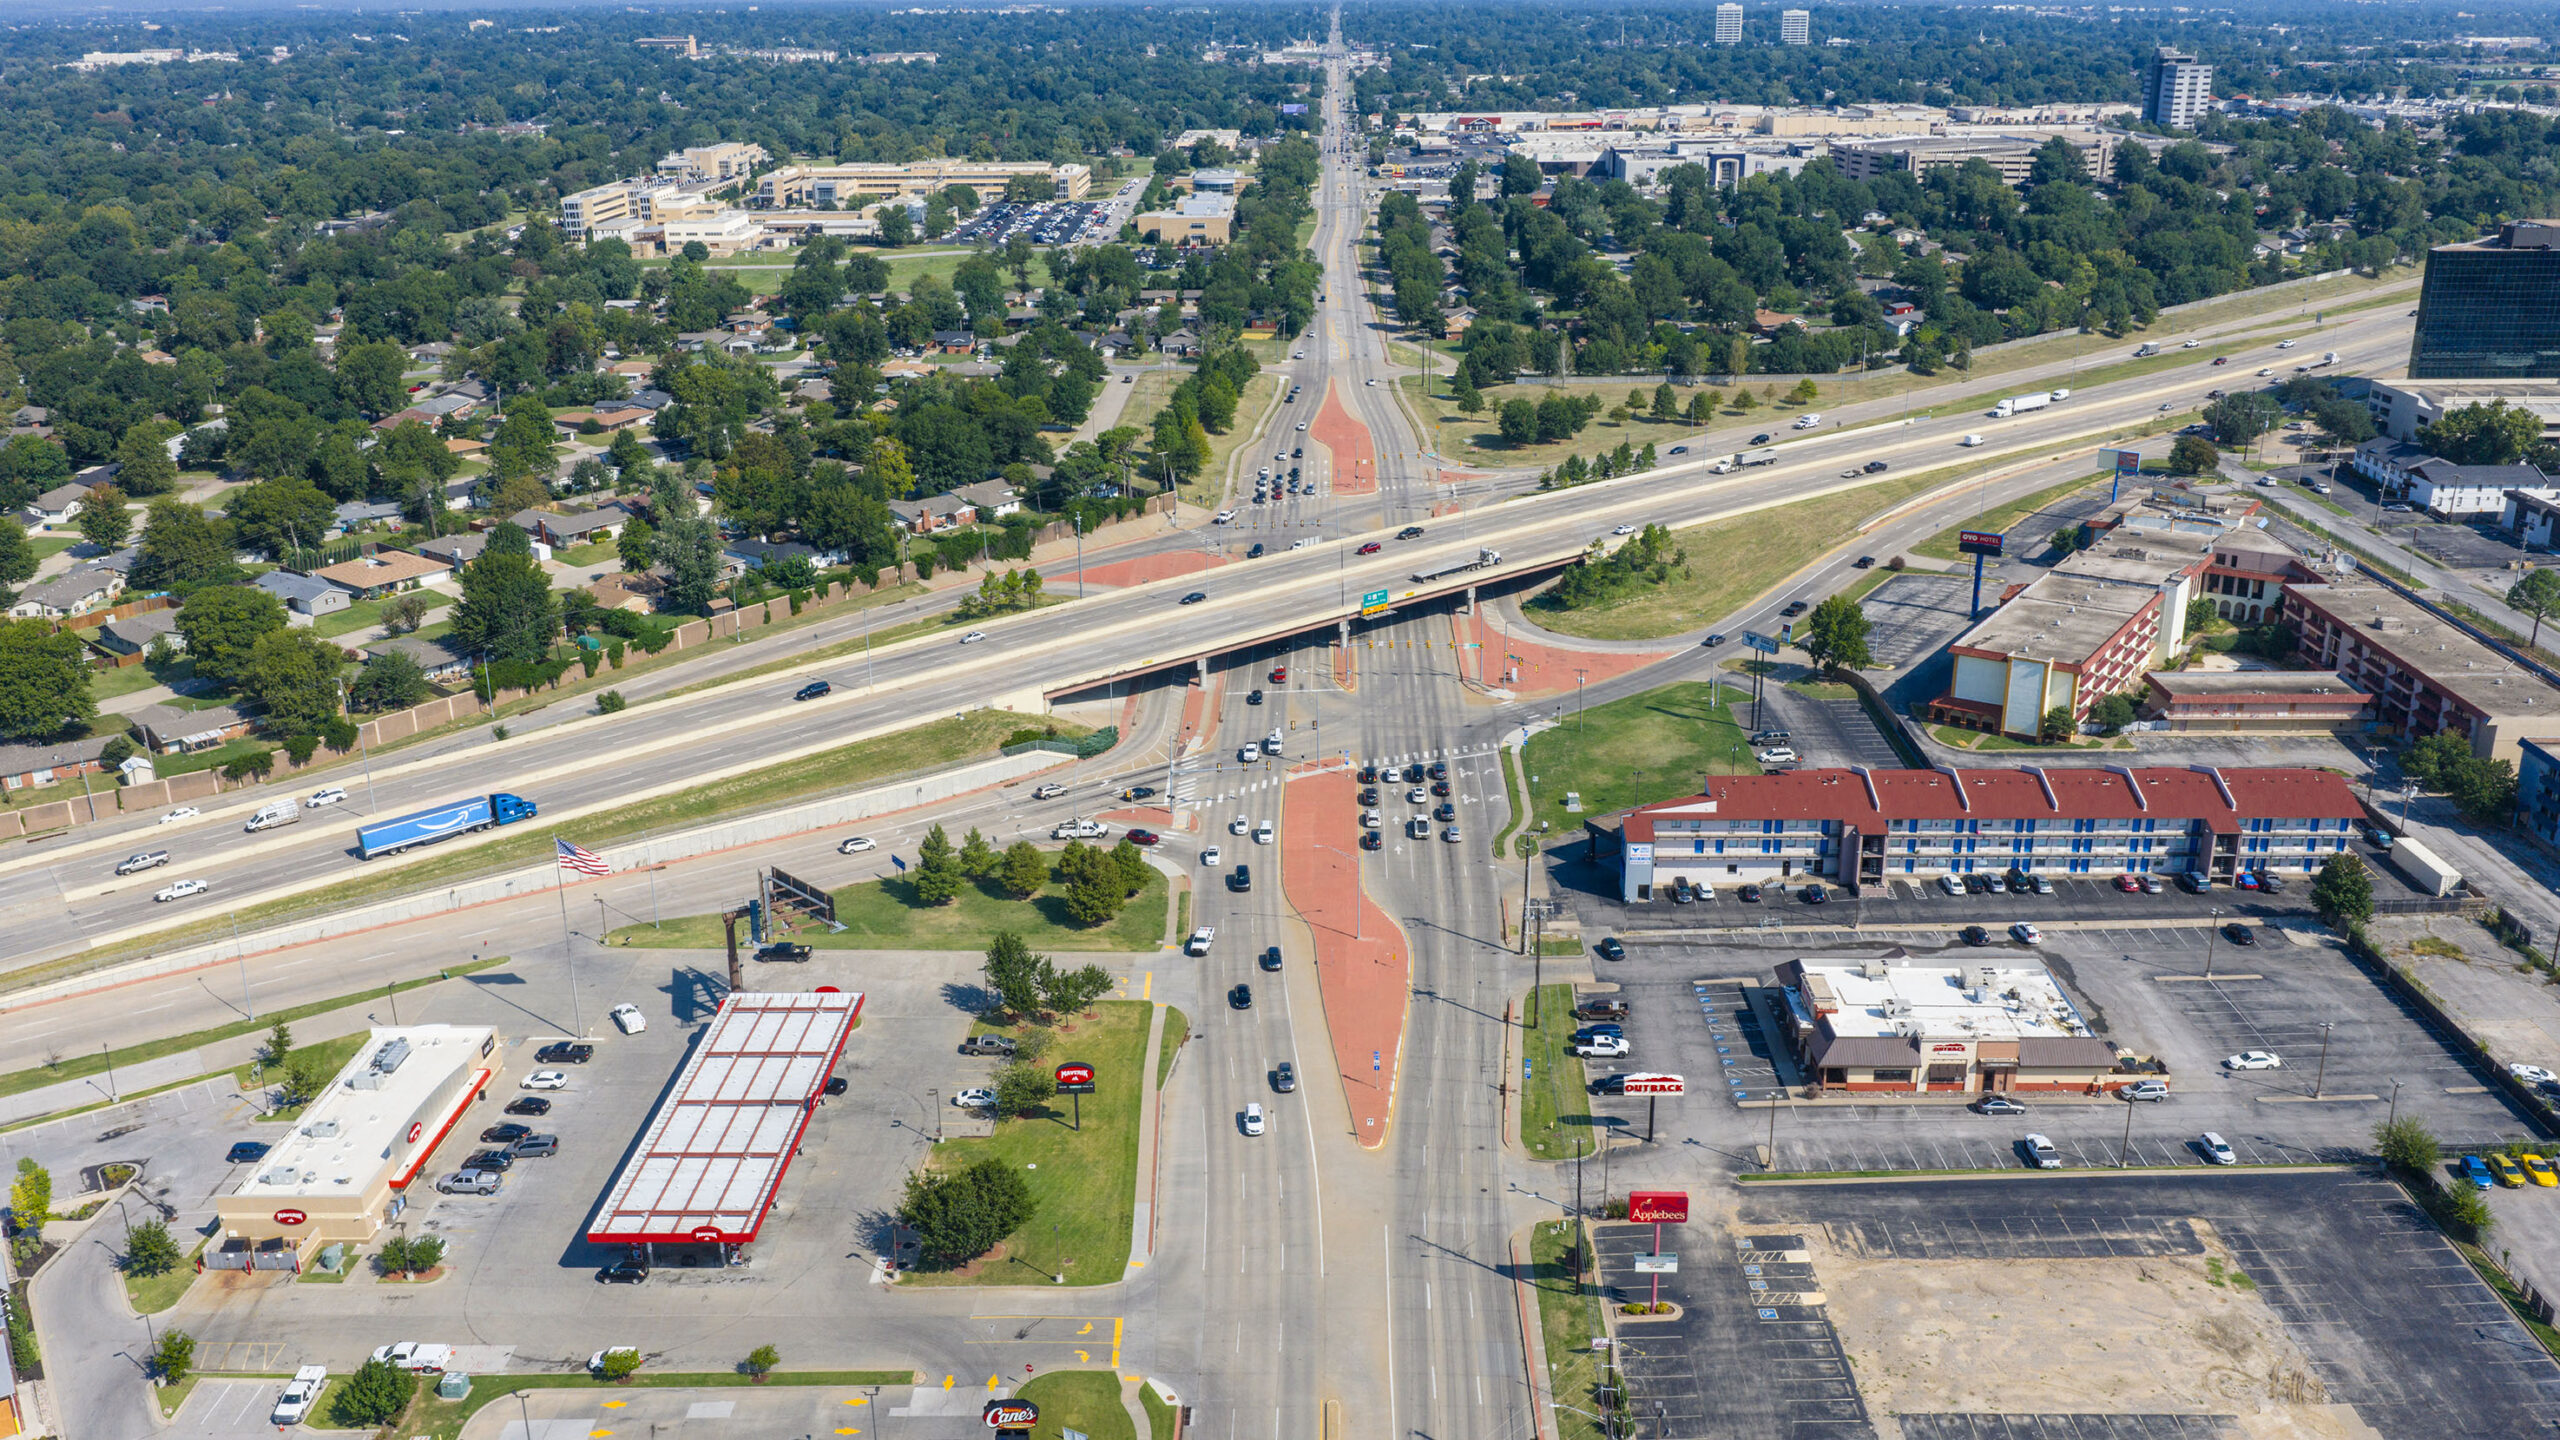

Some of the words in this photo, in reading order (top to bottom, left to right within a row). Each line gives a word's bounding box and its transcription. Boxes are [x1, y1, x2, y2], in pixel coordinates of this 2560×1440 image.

[1060, 1069, 1088, 1079] MAVERIK
[1624, 1084, 1683, 1092] OUTBACK
[1632, 1208, 1686, 1221] Applebee's
[985, 1406, 1037, 1428] Cane's
